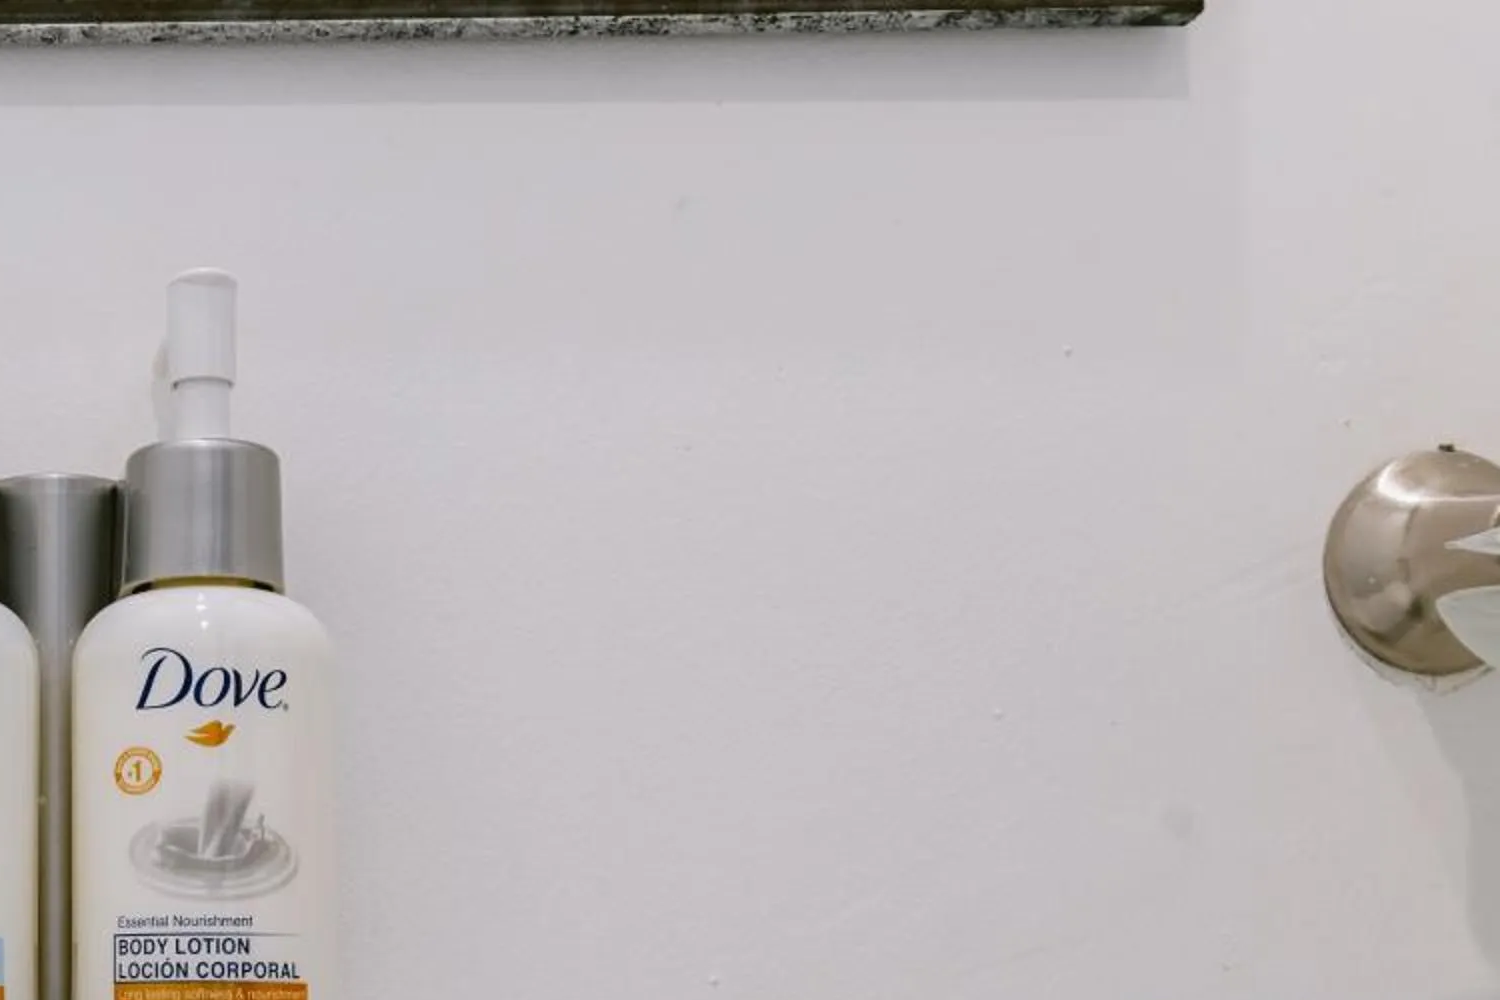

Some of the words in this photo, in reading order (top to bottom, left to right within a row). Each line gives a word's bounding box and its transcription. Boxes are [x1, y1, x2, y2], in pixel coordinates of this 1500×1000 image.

[136, 647, 288, 710] Dove
[117, 915, 169, 929] Essential
[173, 914, 254, 928] Nourishment
[118, 939, 168, 956] BODY
[175, 937, 250, 955] LOTION
[118, 958, 189, 980] LOCIÓN
[196, 961, 301, 979] CORPORAL
[236, 987, 245, 1000] &
